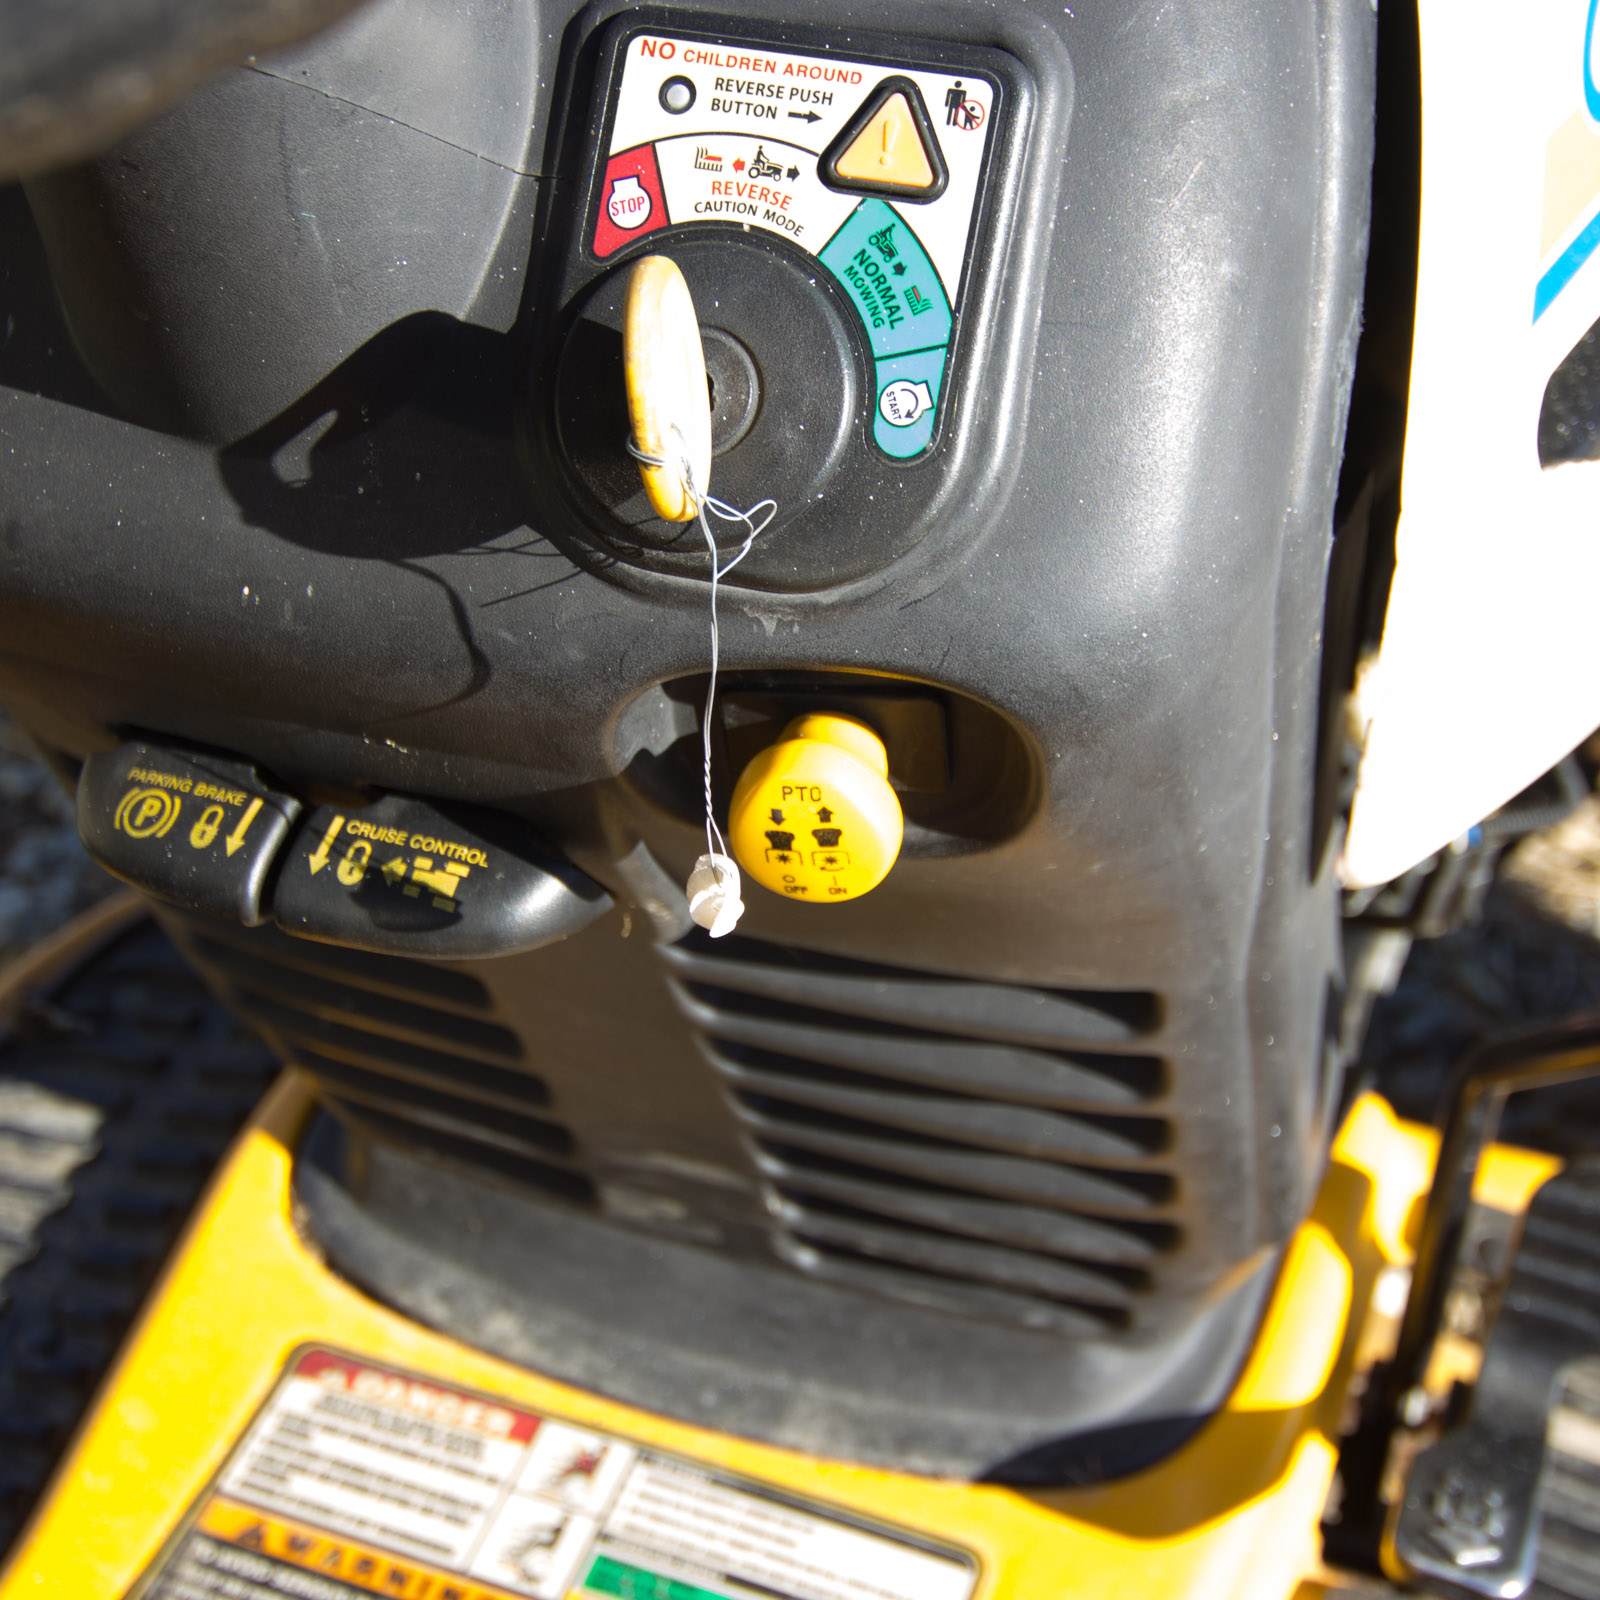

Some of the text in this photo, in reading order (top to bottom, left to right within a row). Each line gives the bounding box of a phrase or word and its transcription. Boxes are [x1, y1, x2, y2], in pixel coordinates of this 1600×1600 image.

[641, 39, 863, 85] NO CHILDREN AROUND
[714, 77, 834, 106] REVERSE PUSH
[711, 98, 778, 119] BUTTON
[611, 196, 645, 217] STOP
[711, 180, 793, 211] REVERSE
[694, 201, 805, 237] CAUTION MODE
[843, 265, 885, 329] MOWING
[853, 248, 904, 330] NORMAL
[885, 390, 902, 420] START
[128, 767, 247, 807] PARKING BRAKE
[782, 786, 822, 802] PTO
[346, 820, 488, 868] CRUISE CONTROL
[784, 885, 847, 896] OFF ON
[350, 1368, 516, 1438] DANGER
